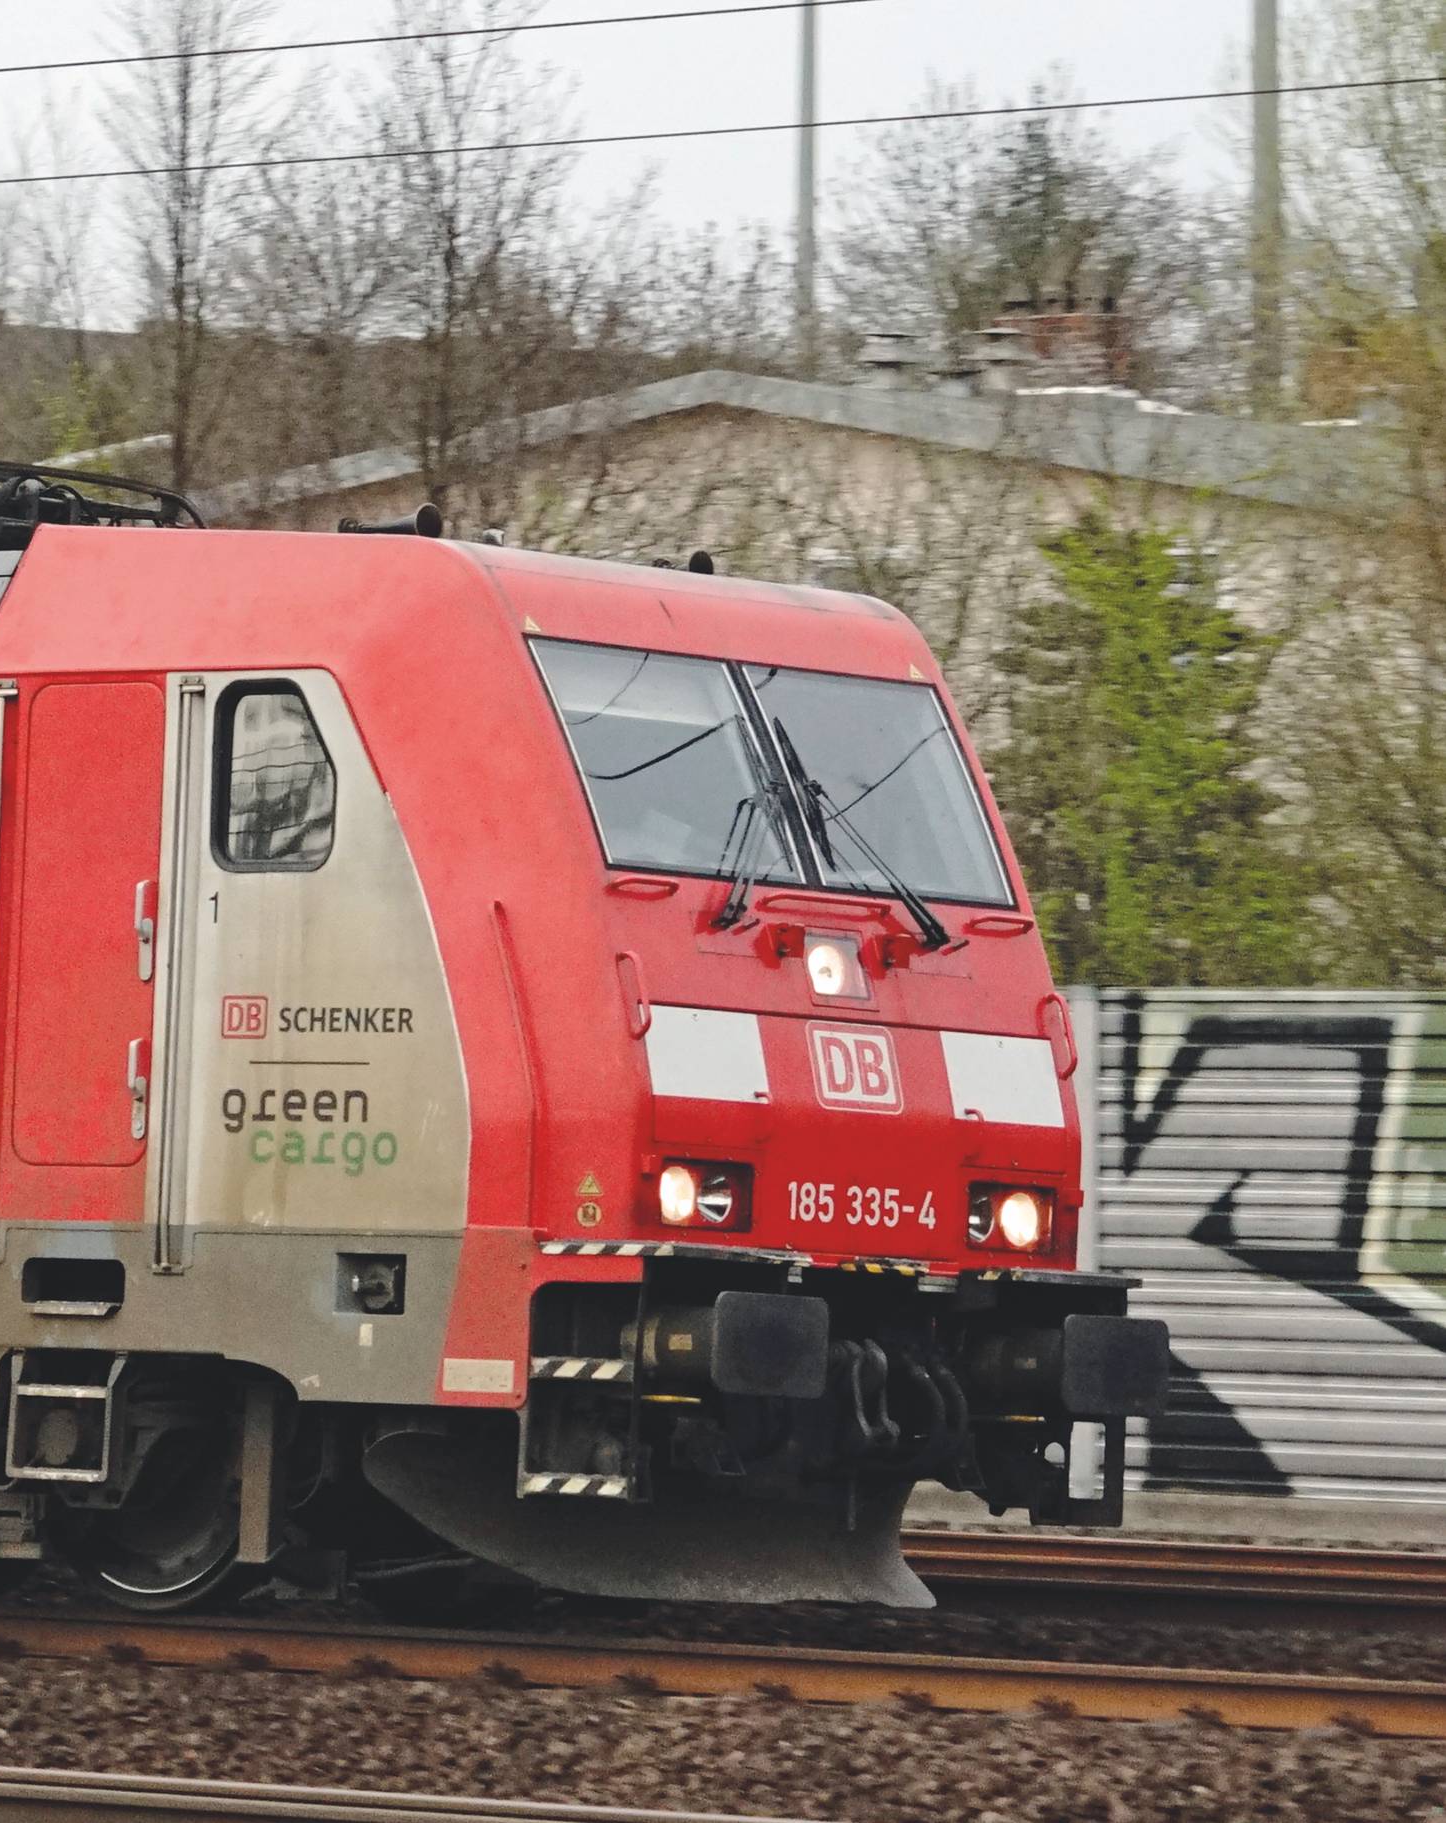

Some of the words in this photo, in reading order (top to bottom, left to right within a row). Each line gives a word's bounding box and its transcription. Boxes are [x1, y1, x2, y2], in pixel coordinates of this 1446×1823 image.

[208, 891, 219, 924] 1
[226, 1002, 262, 1032] DB
[279, 1007, 414, 1033] SCHENKER
[820, 1036, 889, 1096] DB
[222, 1088, 369, 1134] green
[249, 1129, 398, 1177] cargo
[787, 1181, 835, 1223] 185
[845, 1185, 937, 1230] 335-4
